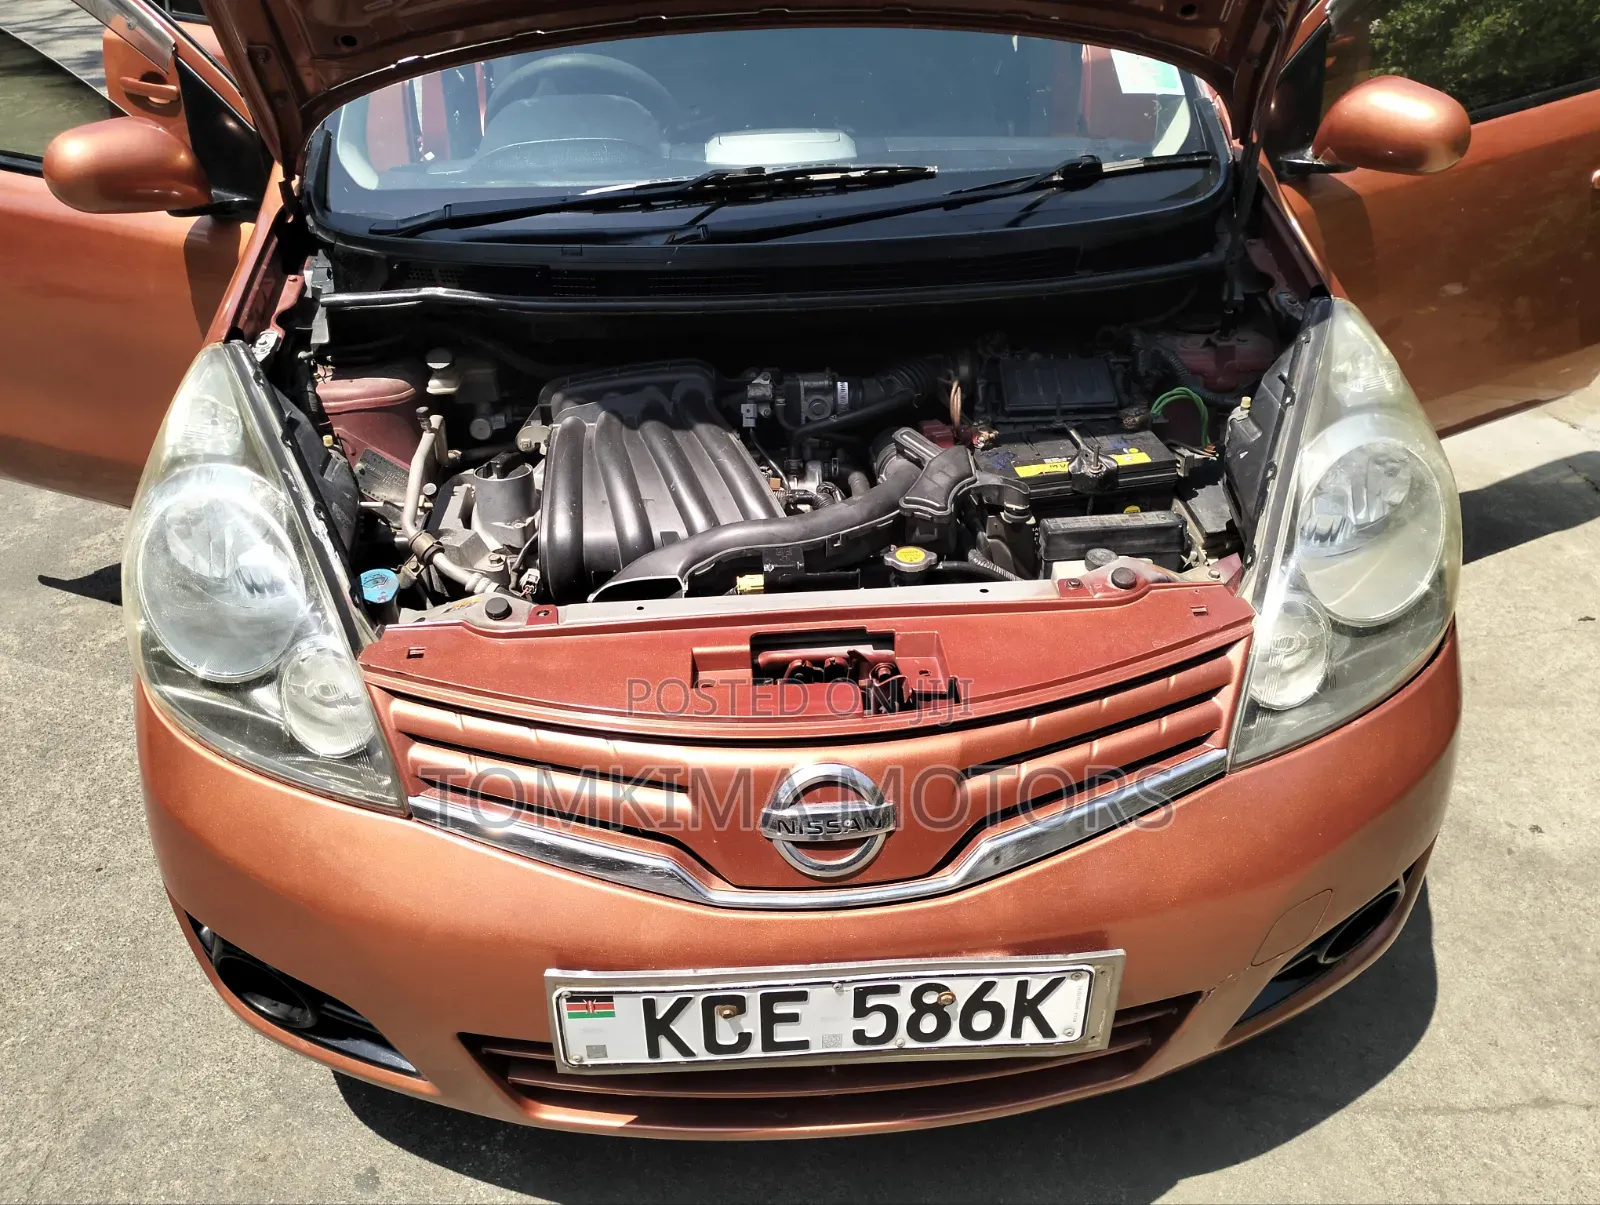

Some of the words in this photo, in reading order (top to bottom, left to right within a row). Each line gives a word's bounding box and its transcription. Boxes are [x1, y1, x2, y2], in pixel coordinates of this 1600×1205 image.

[776, 814, 884, 836] NISSAN
[641, 989, 811, 1059] KCE
[852, 976, 1067, 1046] 586K
